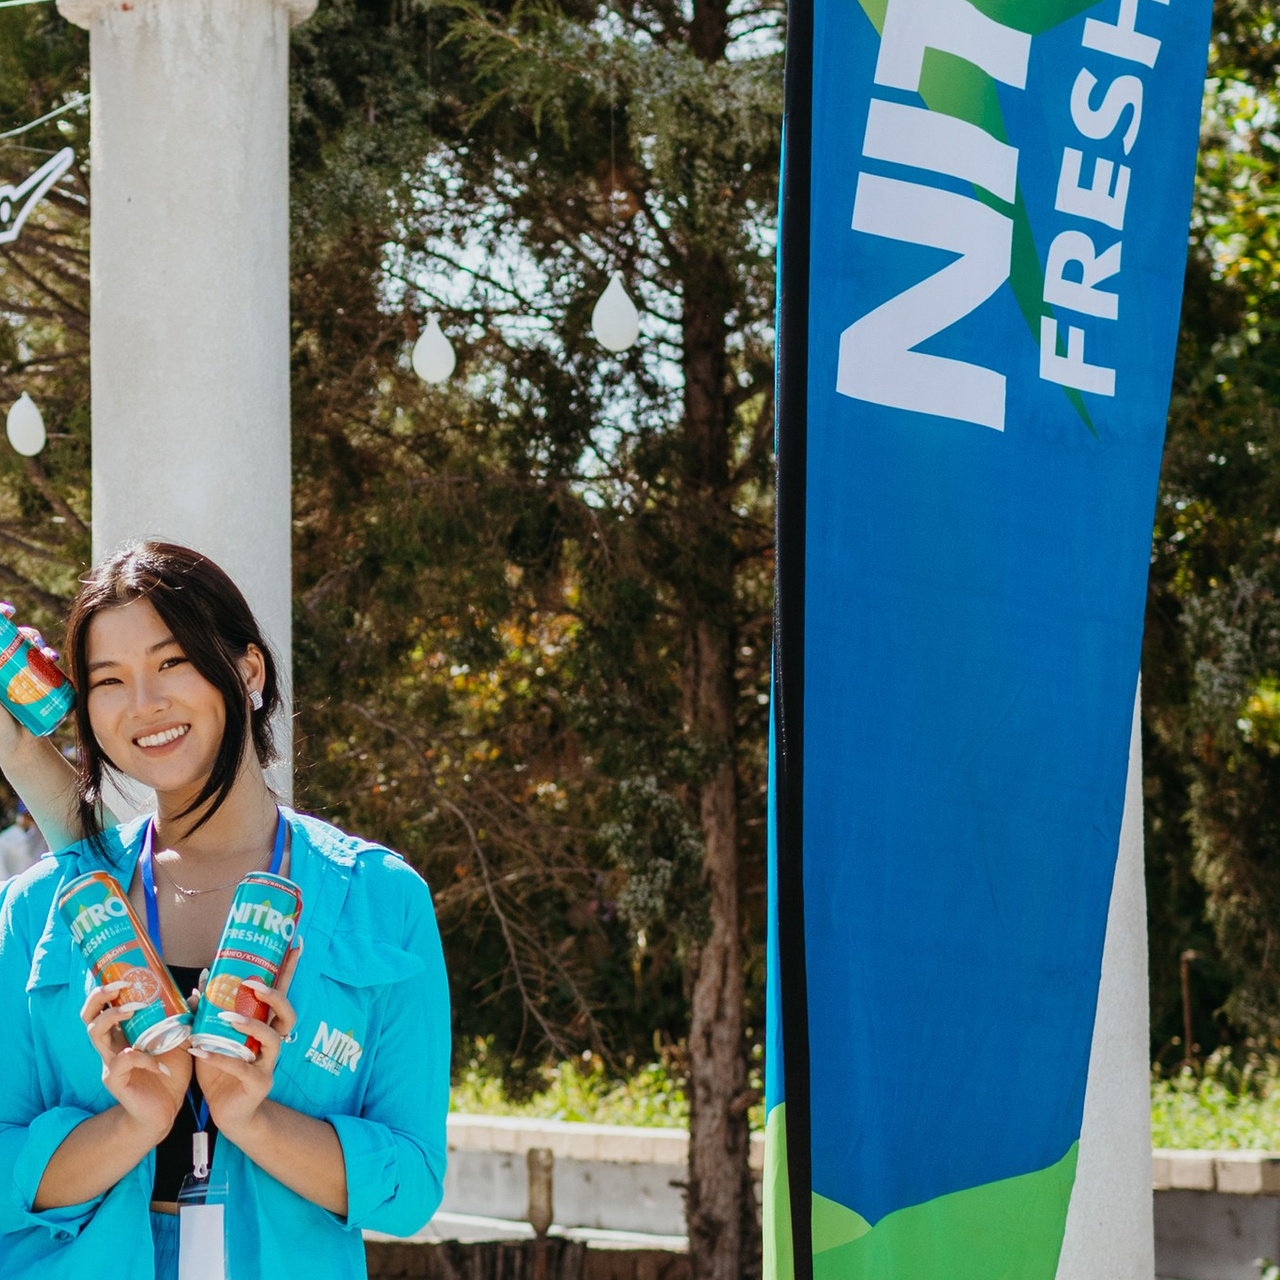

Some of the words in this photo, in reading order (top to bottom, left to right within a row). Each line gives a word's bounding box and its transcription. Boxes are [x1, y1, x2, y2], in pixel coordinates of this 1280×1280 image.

[231, 902, 296, 942] NITRO
[82, 929, 111, 958] RESH!
[225, 928, 268, 947] FRESH!
[96, 944, 127, 970] АПЕЛЬСИН
